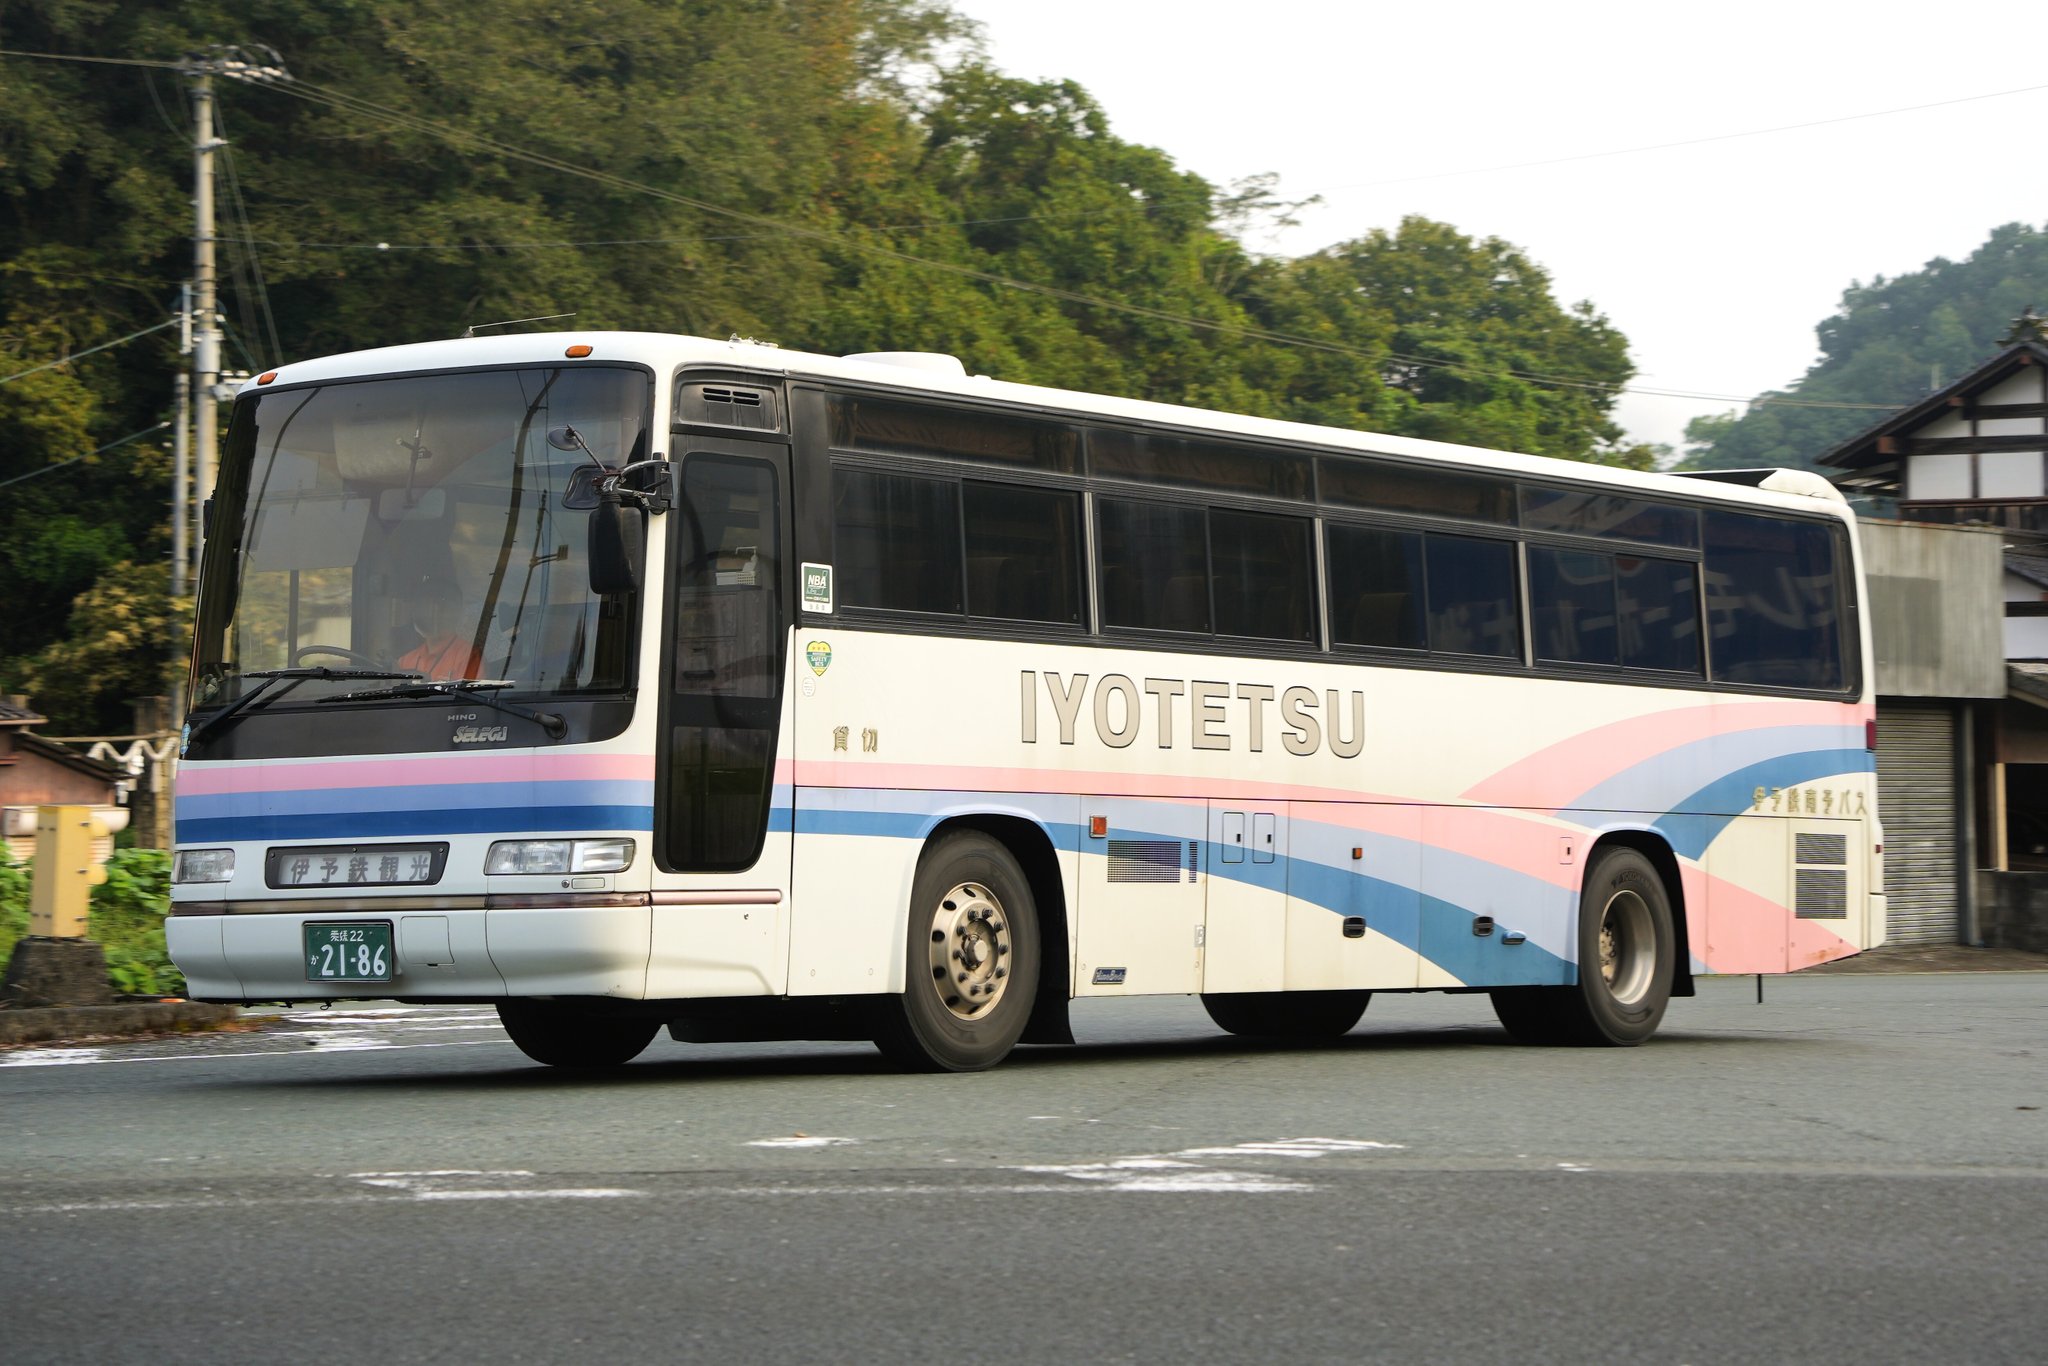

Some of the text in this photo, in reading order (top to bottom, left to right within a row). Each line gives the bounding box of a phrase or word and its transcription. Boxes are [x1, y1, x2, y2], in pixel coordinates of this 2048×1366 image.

[807, 574, 827, 588] NBA
[1021, 670, 1365, 759] IYOTETSU
[832, 725, 878, 752] 貸切
[290, 855, 429, 884] 伊予鉄観光
[310, 944, 386, 976] か 21-86
